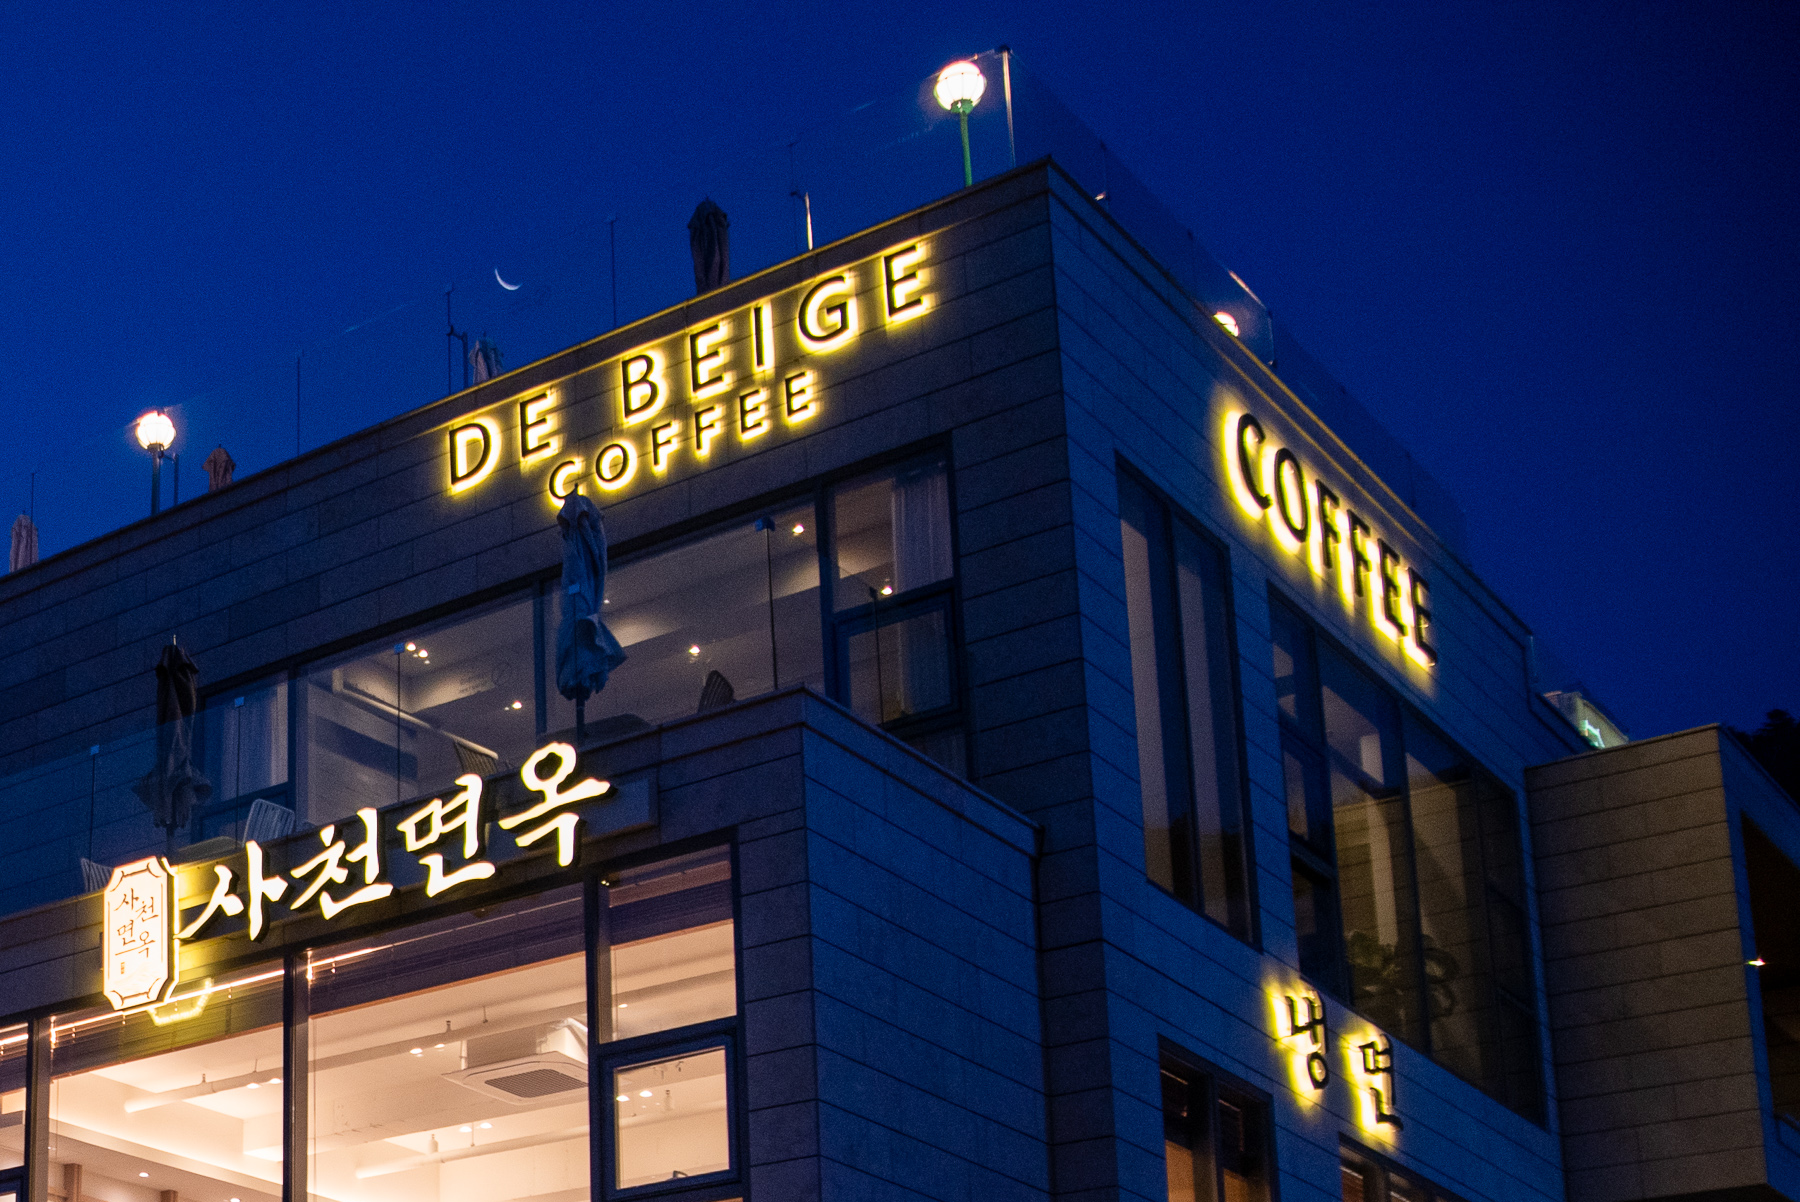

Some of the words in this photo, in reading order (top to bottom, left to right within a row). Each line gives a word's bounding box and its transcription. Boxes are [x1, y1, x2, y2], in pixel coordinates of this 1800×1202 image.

[448, 387, 558, 492] DE
[620, 240, 930, 426] BEIGE
[548, 370, 818, 505] COFFEE
[1228, 411, 1438, 670] COFFEE
[114, 887, 159, 923] 사천
[177, 742, 611, 942] 사천면옥
[115, 919, 157, 958] 면옥
[1276, 986, 1404, 1133] 냉면
